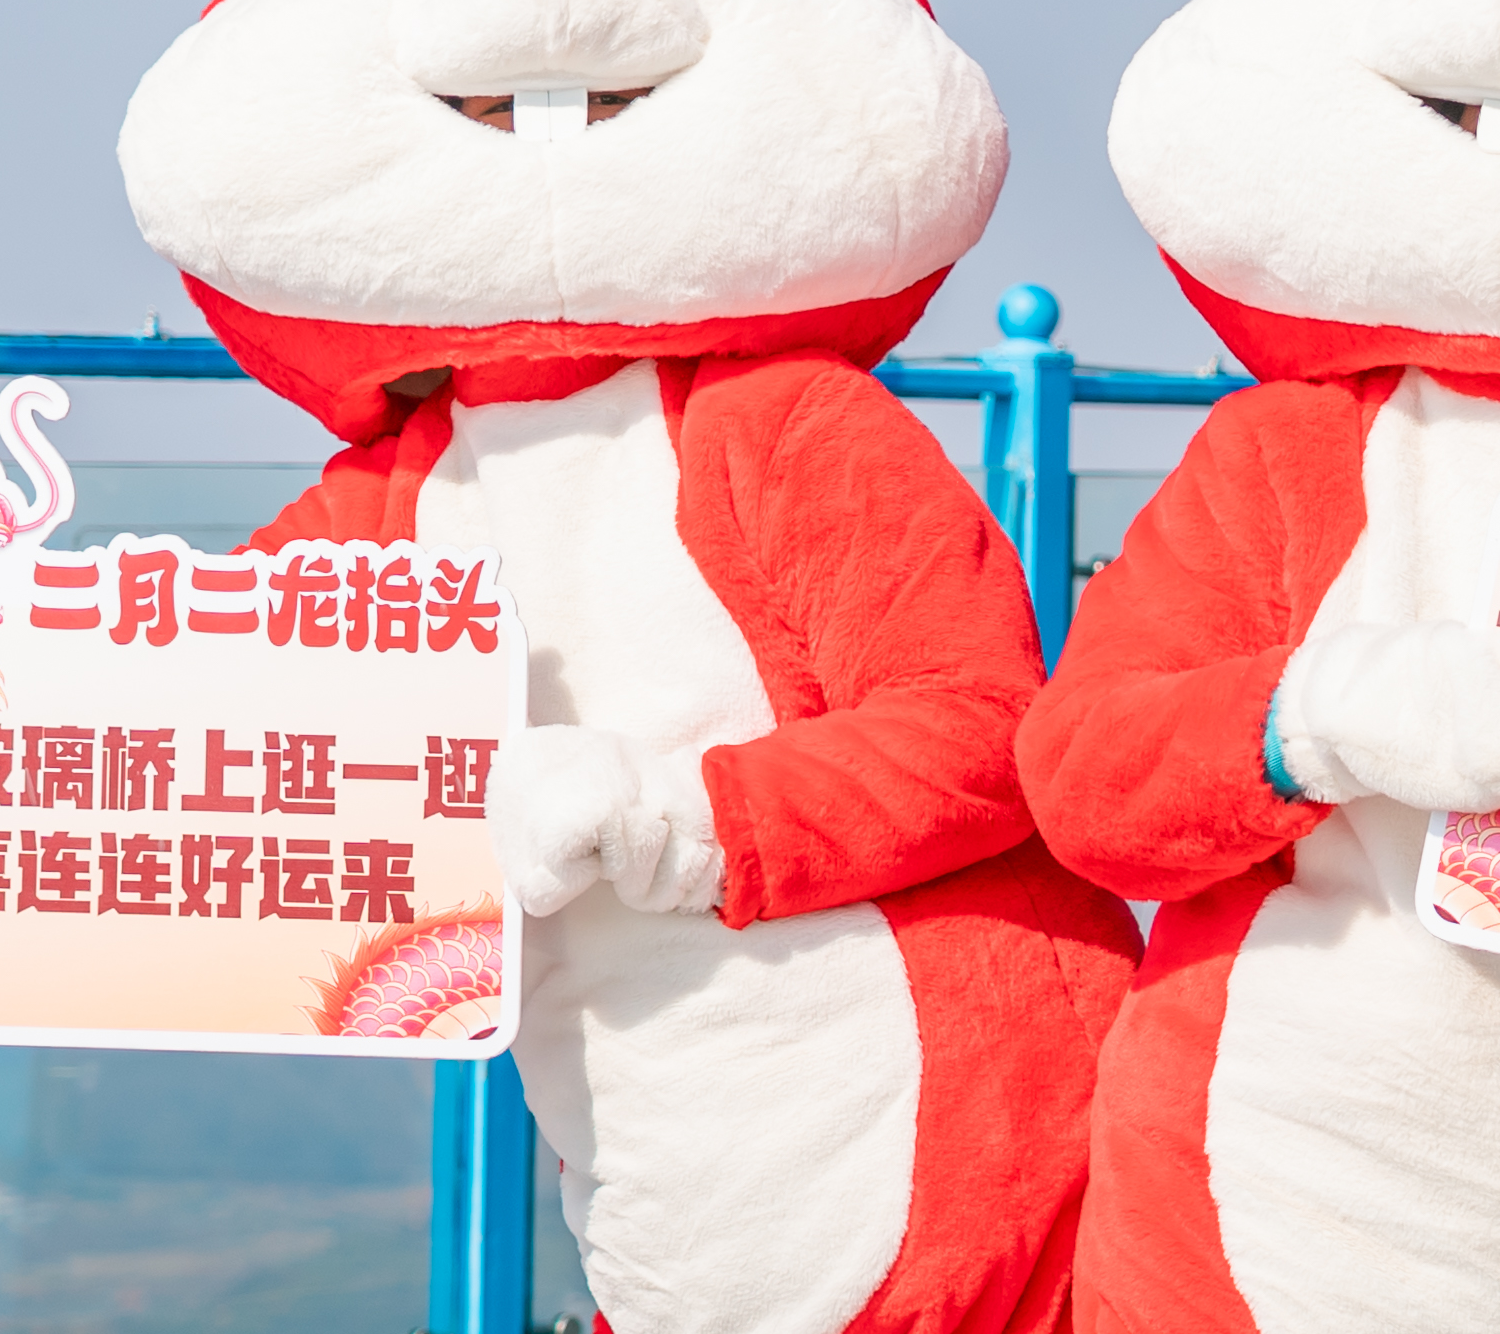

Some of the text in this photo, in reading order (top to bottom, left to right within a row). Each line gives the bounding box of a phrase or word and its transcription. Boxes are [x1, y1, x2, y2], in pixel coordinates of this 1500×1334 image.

[29, 549, 502, 654] 二月二龙抬头
